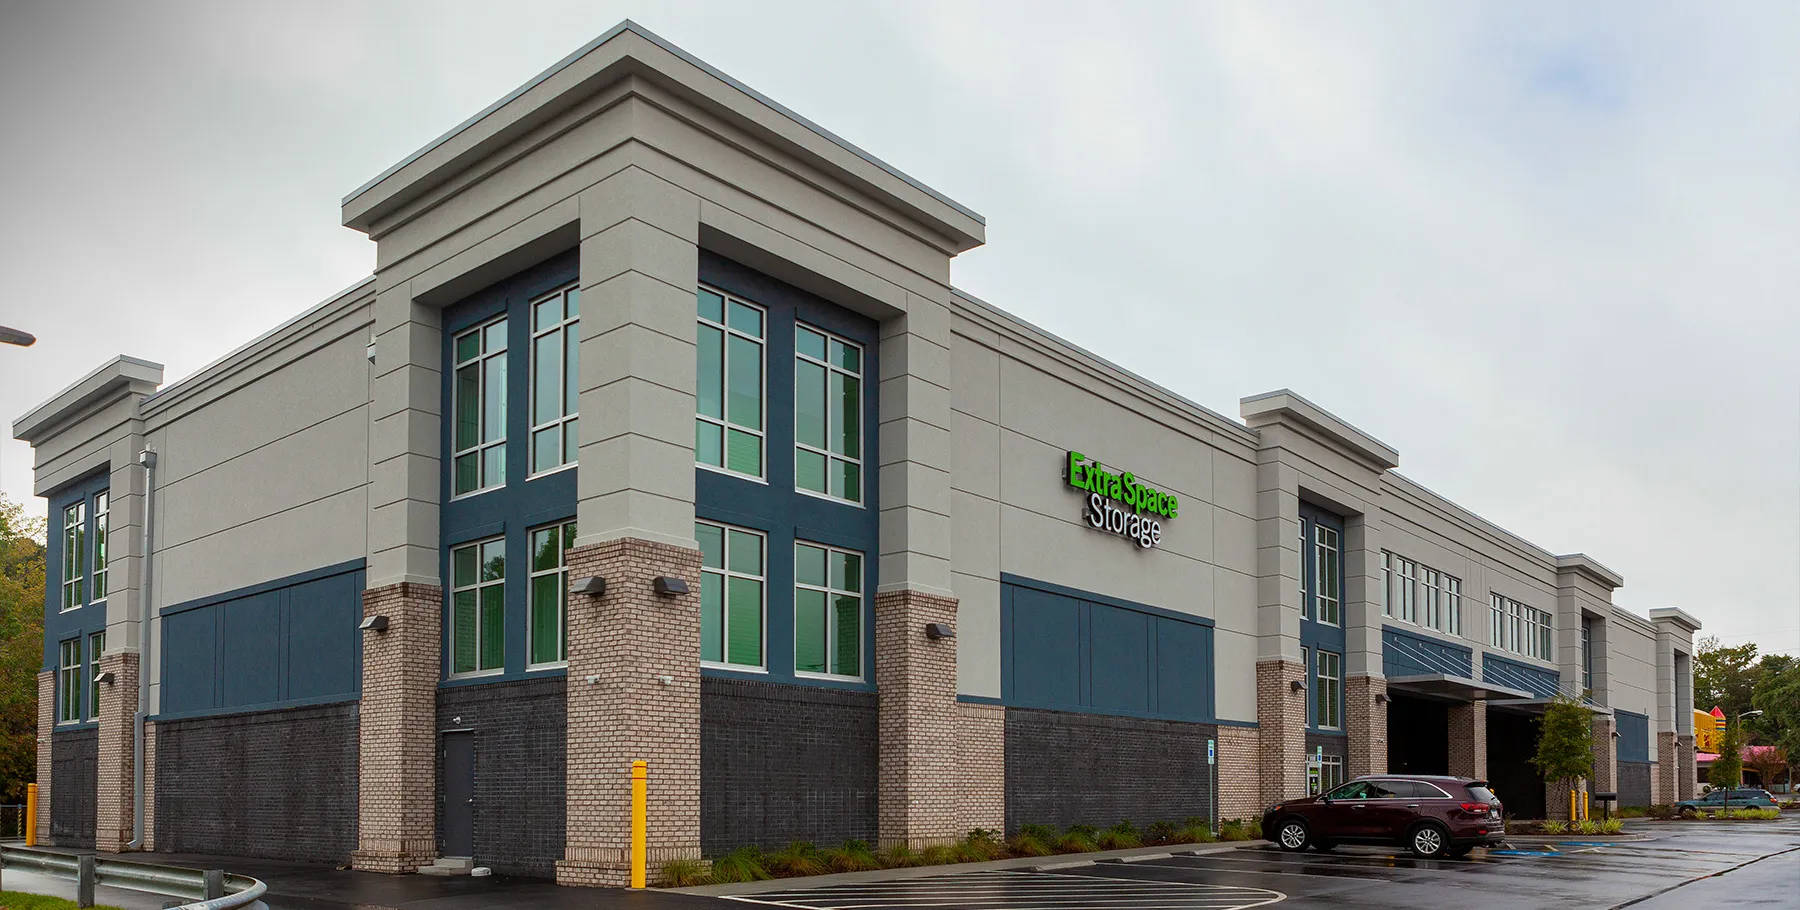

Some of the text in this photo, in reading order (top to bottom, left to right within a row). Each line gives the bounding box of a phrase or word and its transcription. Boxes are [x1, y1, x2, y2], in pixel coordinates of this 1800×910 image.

[1068, 451, 1178, 519] Extra Space
[1090, 492, 1161, 548] Storage
